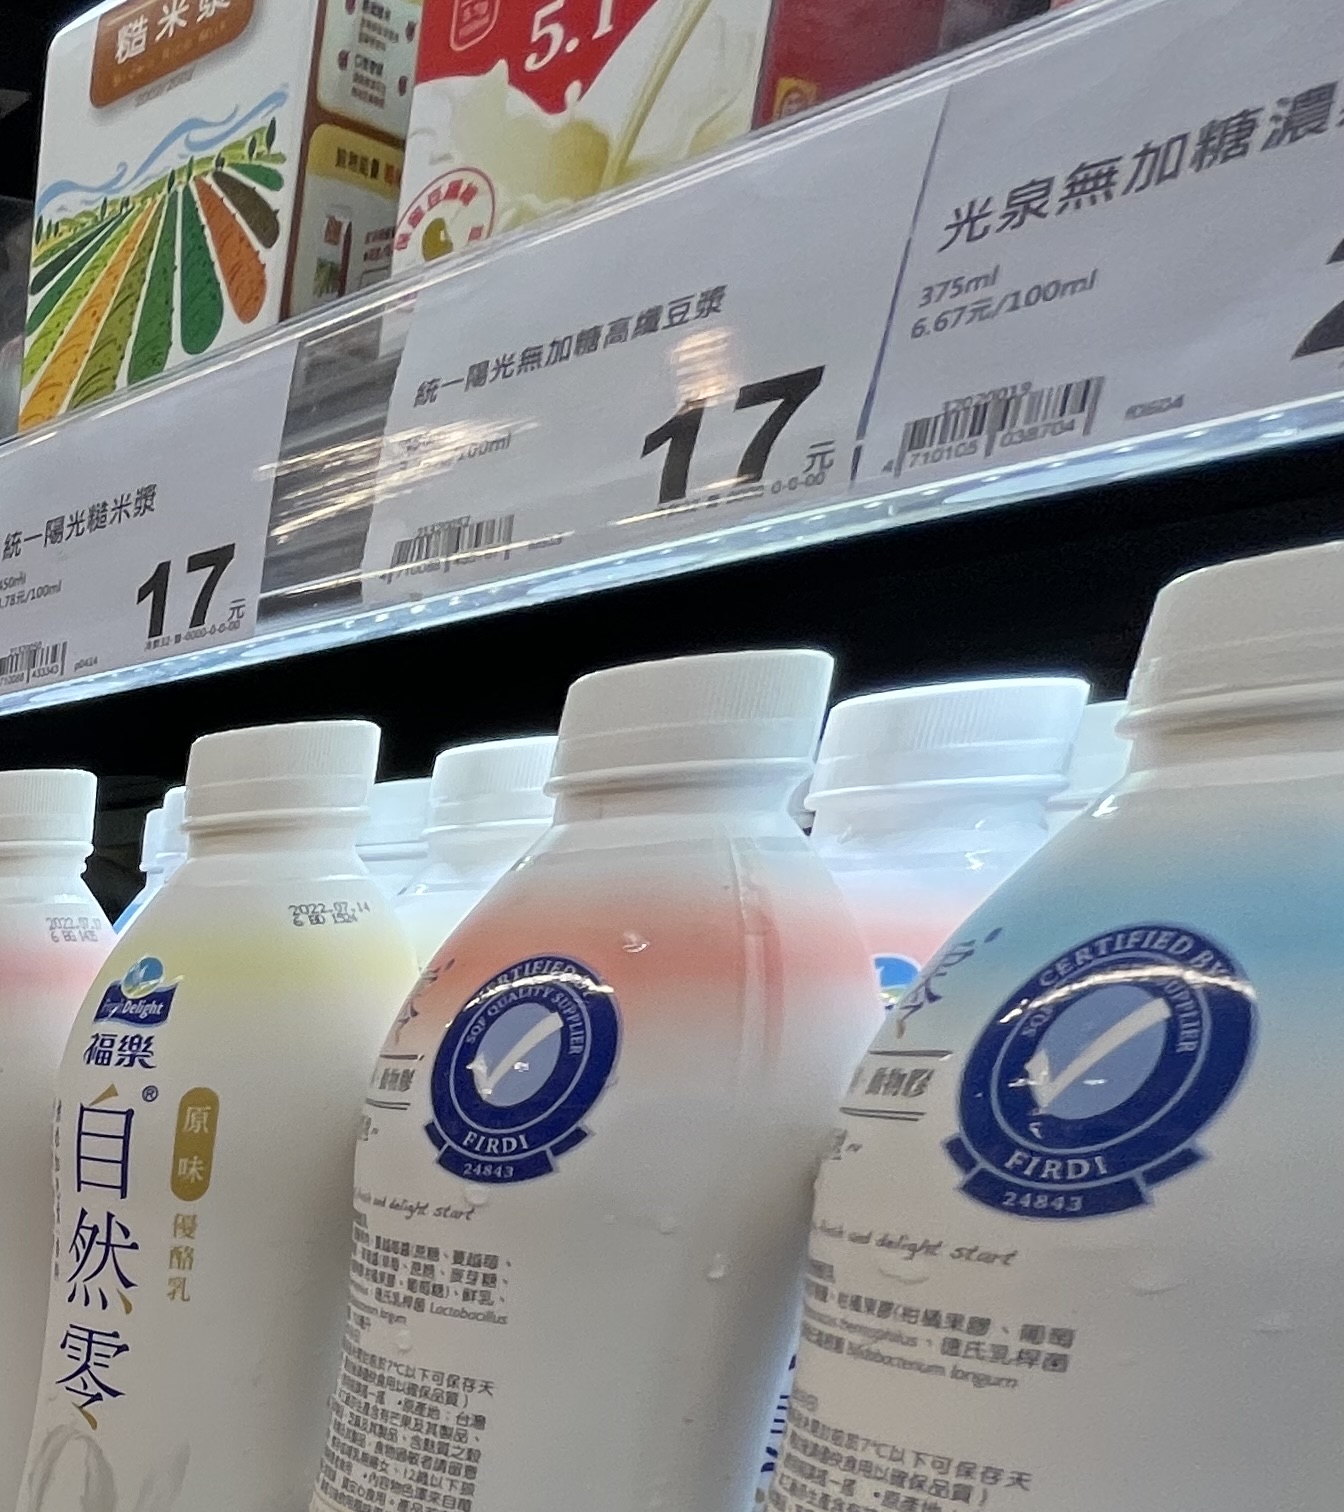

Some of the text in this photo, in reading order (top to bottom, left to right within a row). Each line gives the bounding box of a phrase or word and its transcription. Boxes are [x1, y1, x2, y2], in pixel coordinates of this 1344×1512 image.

[937, 82, 1344, 252] 光泉無加糖濃
[909, 268, 1099, 341] 6.67元/100ml
[918, 264, 1000, 308] 375ml
[413, 284, 728, 407] 統一陽光無加糖高纖豆漿
[639, 365, 835, 505] 17 元
[2, 485, 157, 560] 統一陽光糙米漿
[136, 542, 236, 640] 17
[228, 599, 246, 620] 元
[1038, 929, 1195, 988] CERTIFIED
[123, 999, 165, 1018] Delight
[486, 986, 555, 1016] QUALITY
[551, 992, 586, 1056] SUPPLIER
[1165, 979, 1202, 1053] UPPLIER
[83, 1033, 157, 1070] 福樂
[178, 1104, 212, 1185] 原味
[462, 1163, 514, 1178] 24843
[463, 1130, 529, 1154] FIRDI
[1004, 1150, 1109, 1181] FIRDI
[433, 1205, 476, 1221] start
[1002, 1190, 1084, 1213] 24843
[56, 1083, 140, 1430] 自然零
[167, 1211, 197, 1303] 優酪乳
[876, 1233, 1019, 1266] delight start
[429, 1301, 509, 1325] Lactobacillus
